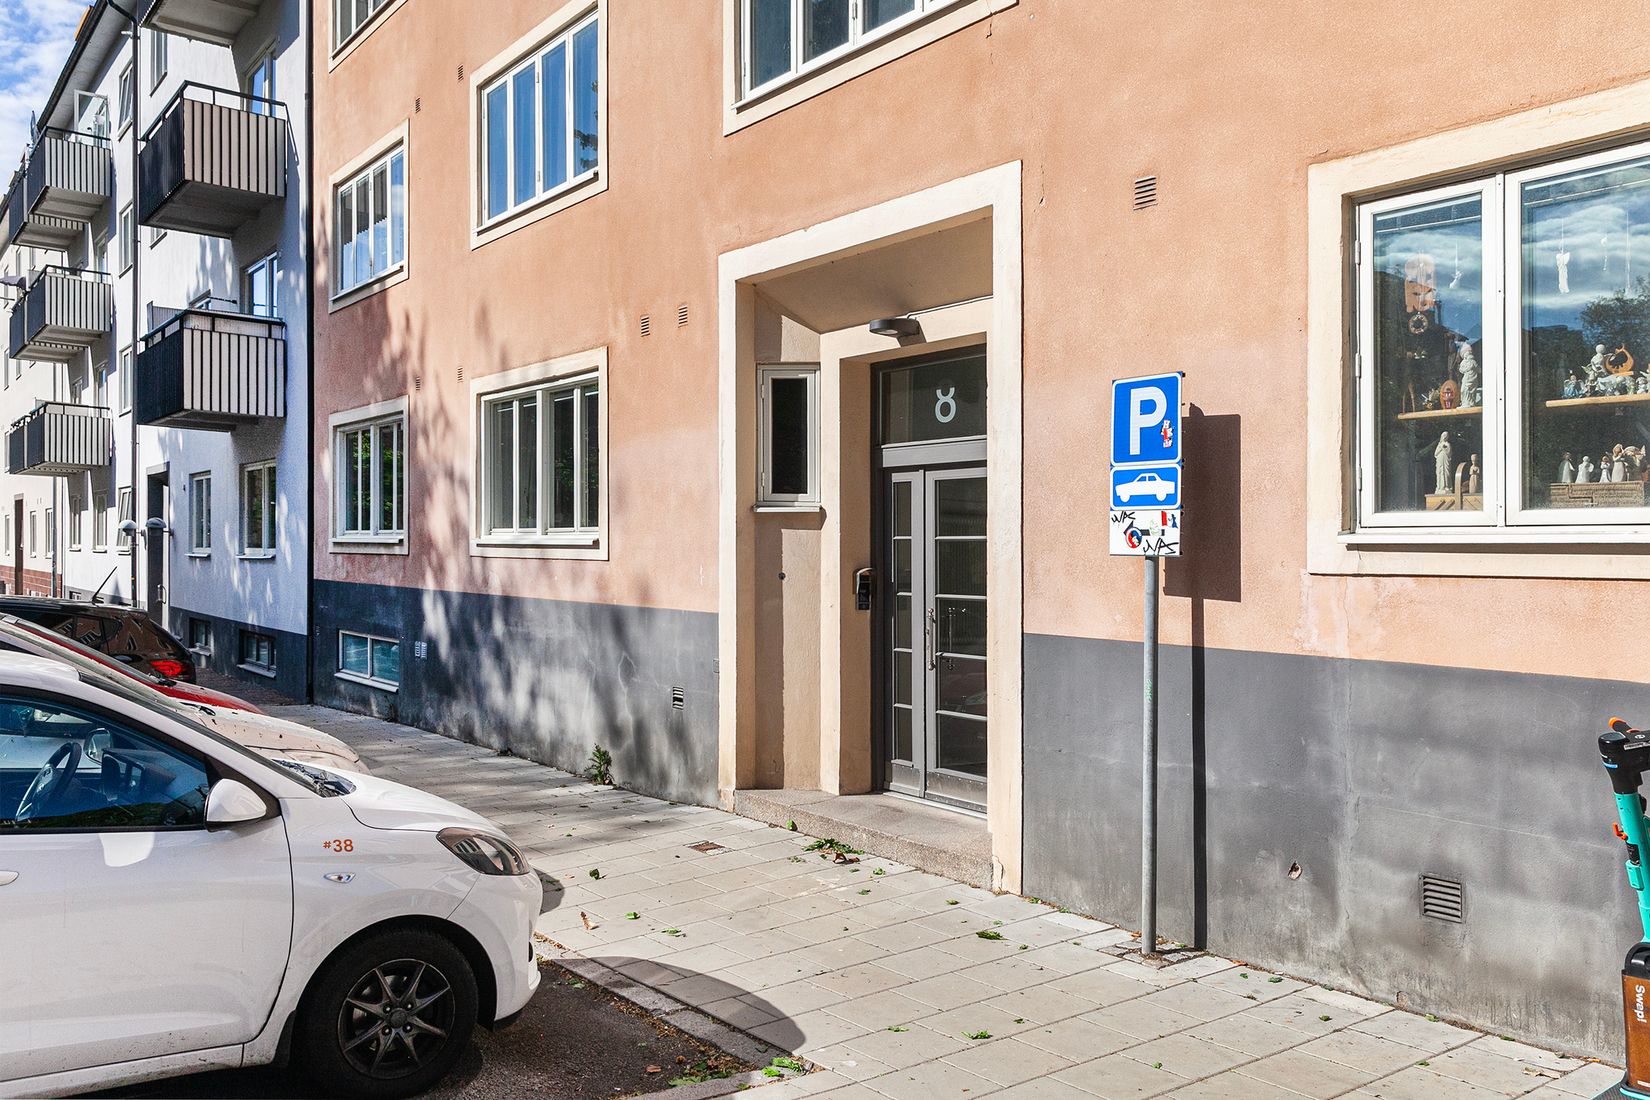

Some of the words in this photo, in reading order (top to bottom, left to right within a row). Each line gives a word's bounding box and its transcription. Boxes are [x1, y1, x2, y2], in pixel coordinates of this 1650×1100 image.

[935, 387, 956, 423] 8
[1130, 387, 1167, 455] P
[323, 839, 353, 852] #38
